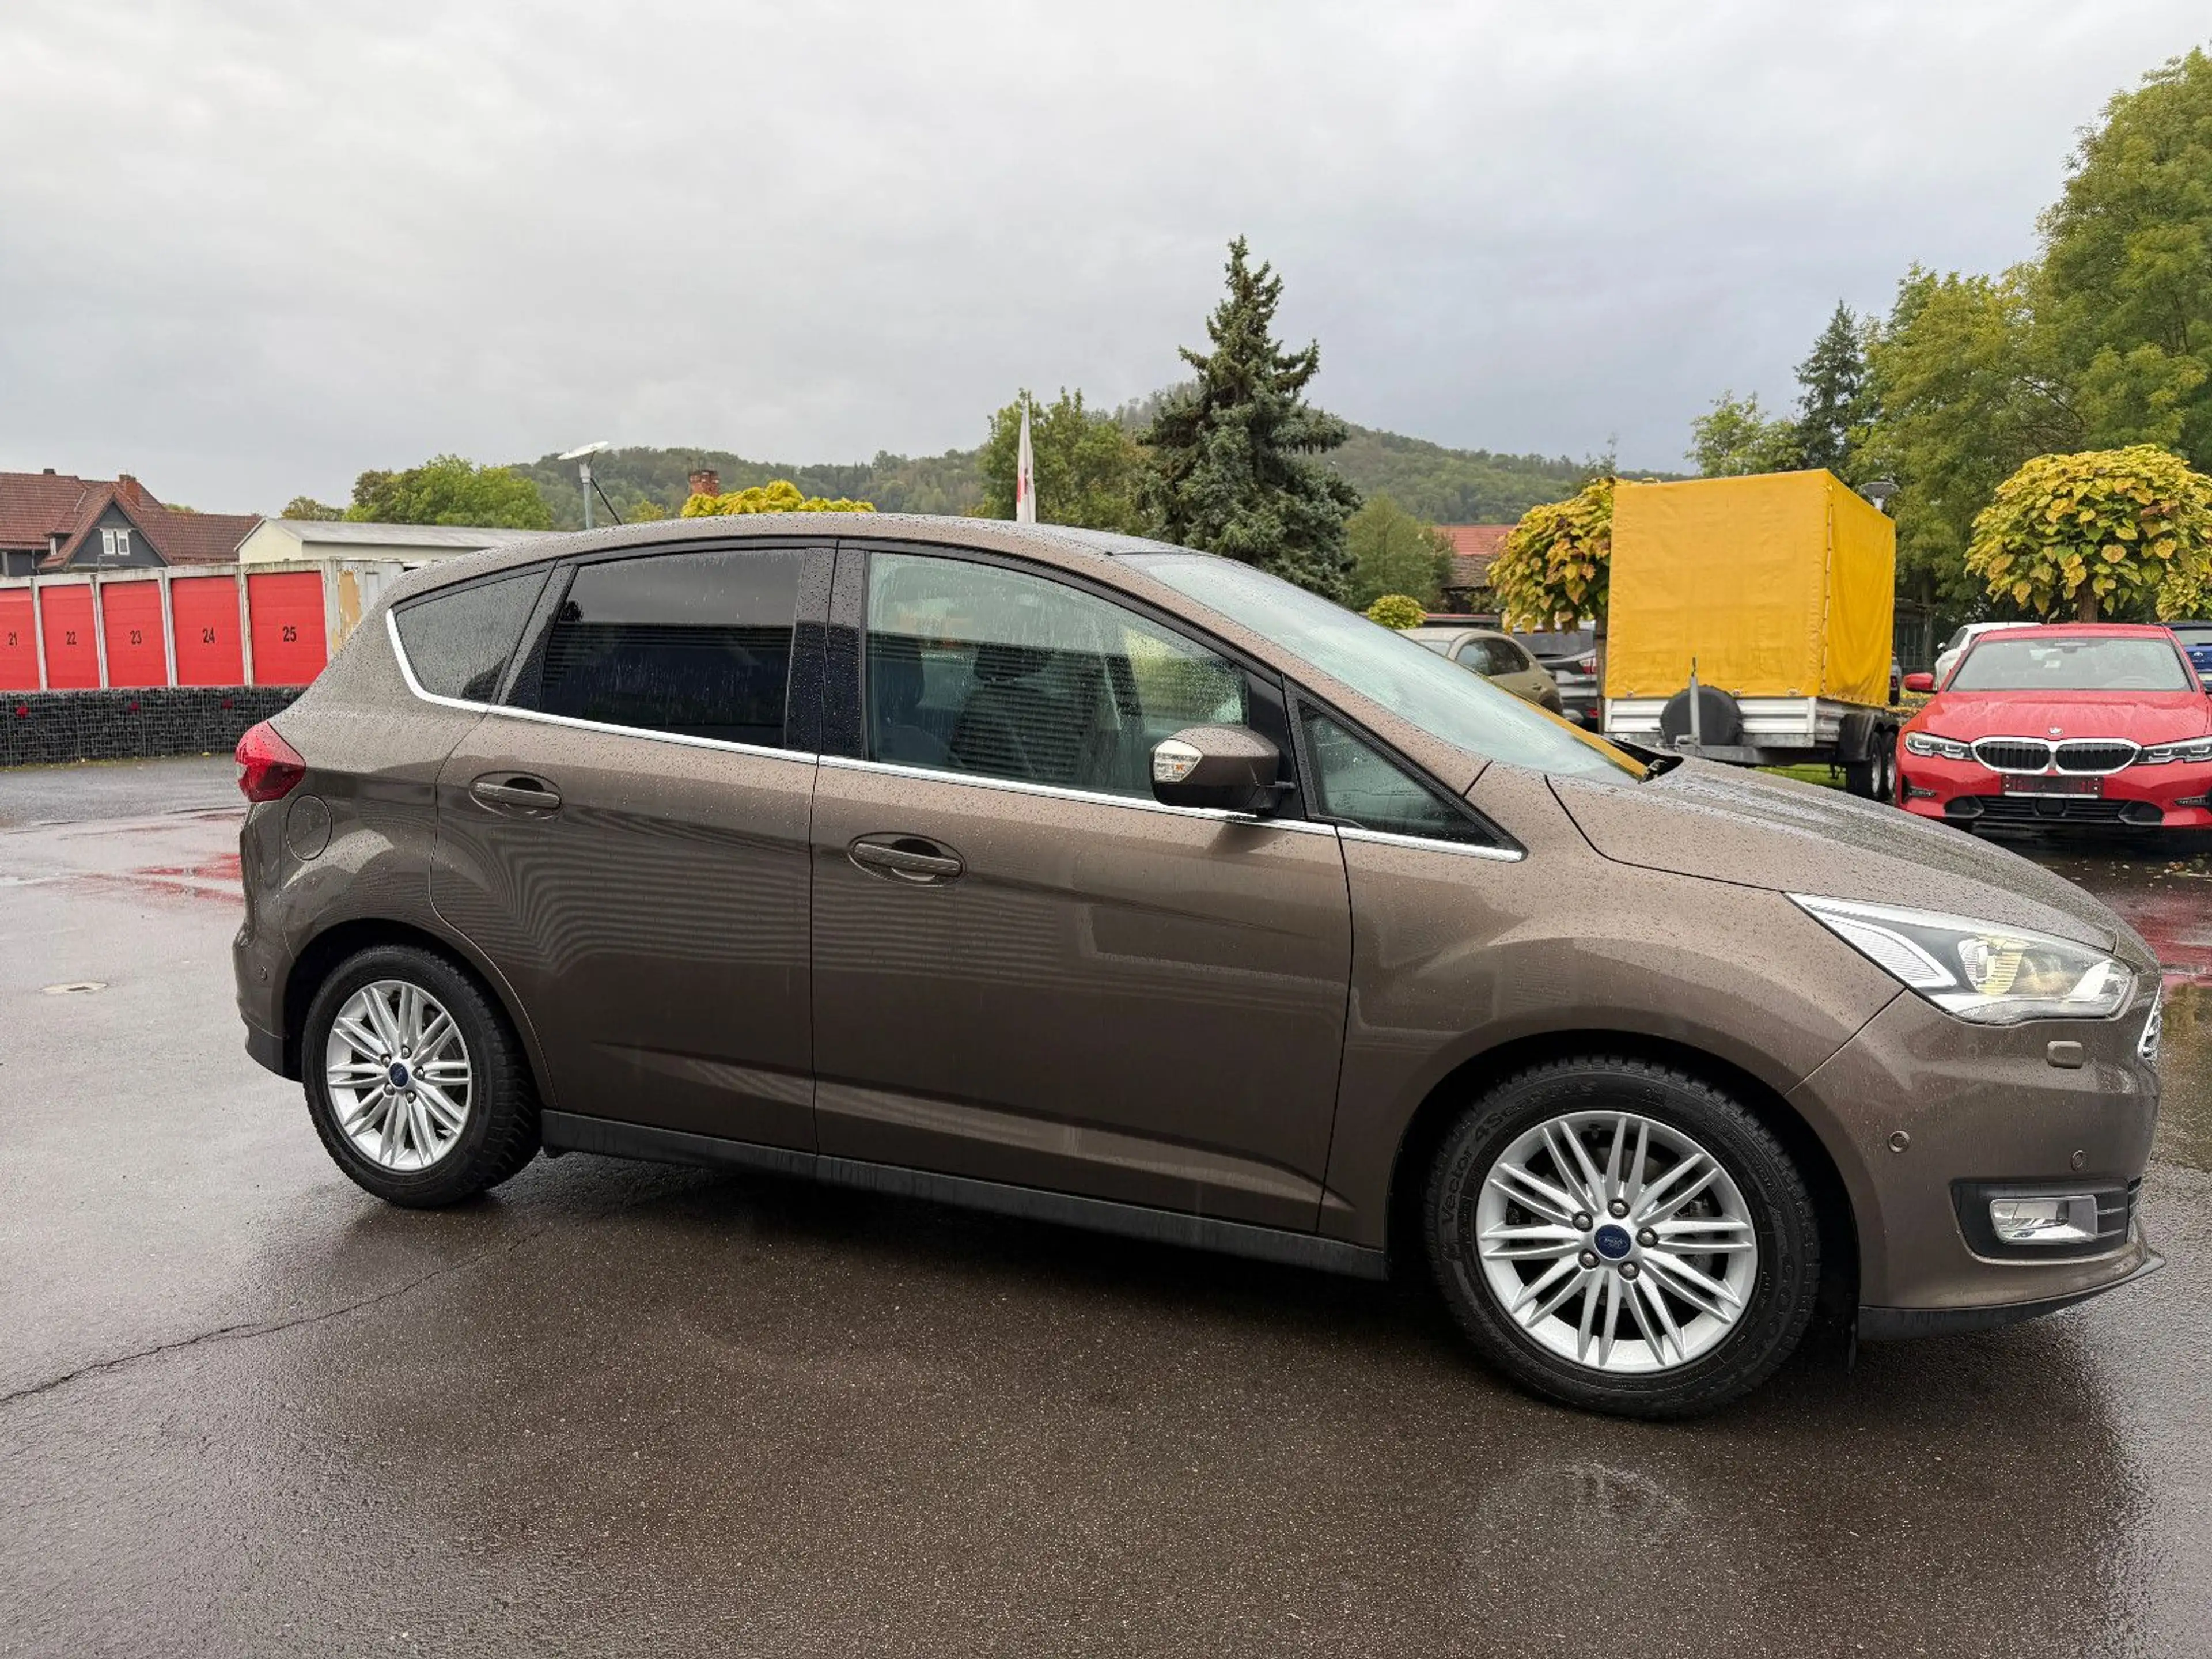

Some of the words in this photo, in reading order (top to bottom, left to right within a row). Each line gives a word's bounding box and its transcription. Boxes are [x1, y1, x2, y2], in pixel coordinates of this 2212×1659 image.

[8, 632, 17, 646] 21
[66, 631, 77, 645] 22
[130, 630, 142, 644] 23
[203, 627, 215, 643] 24
[283, 626, 297, 642] 25
